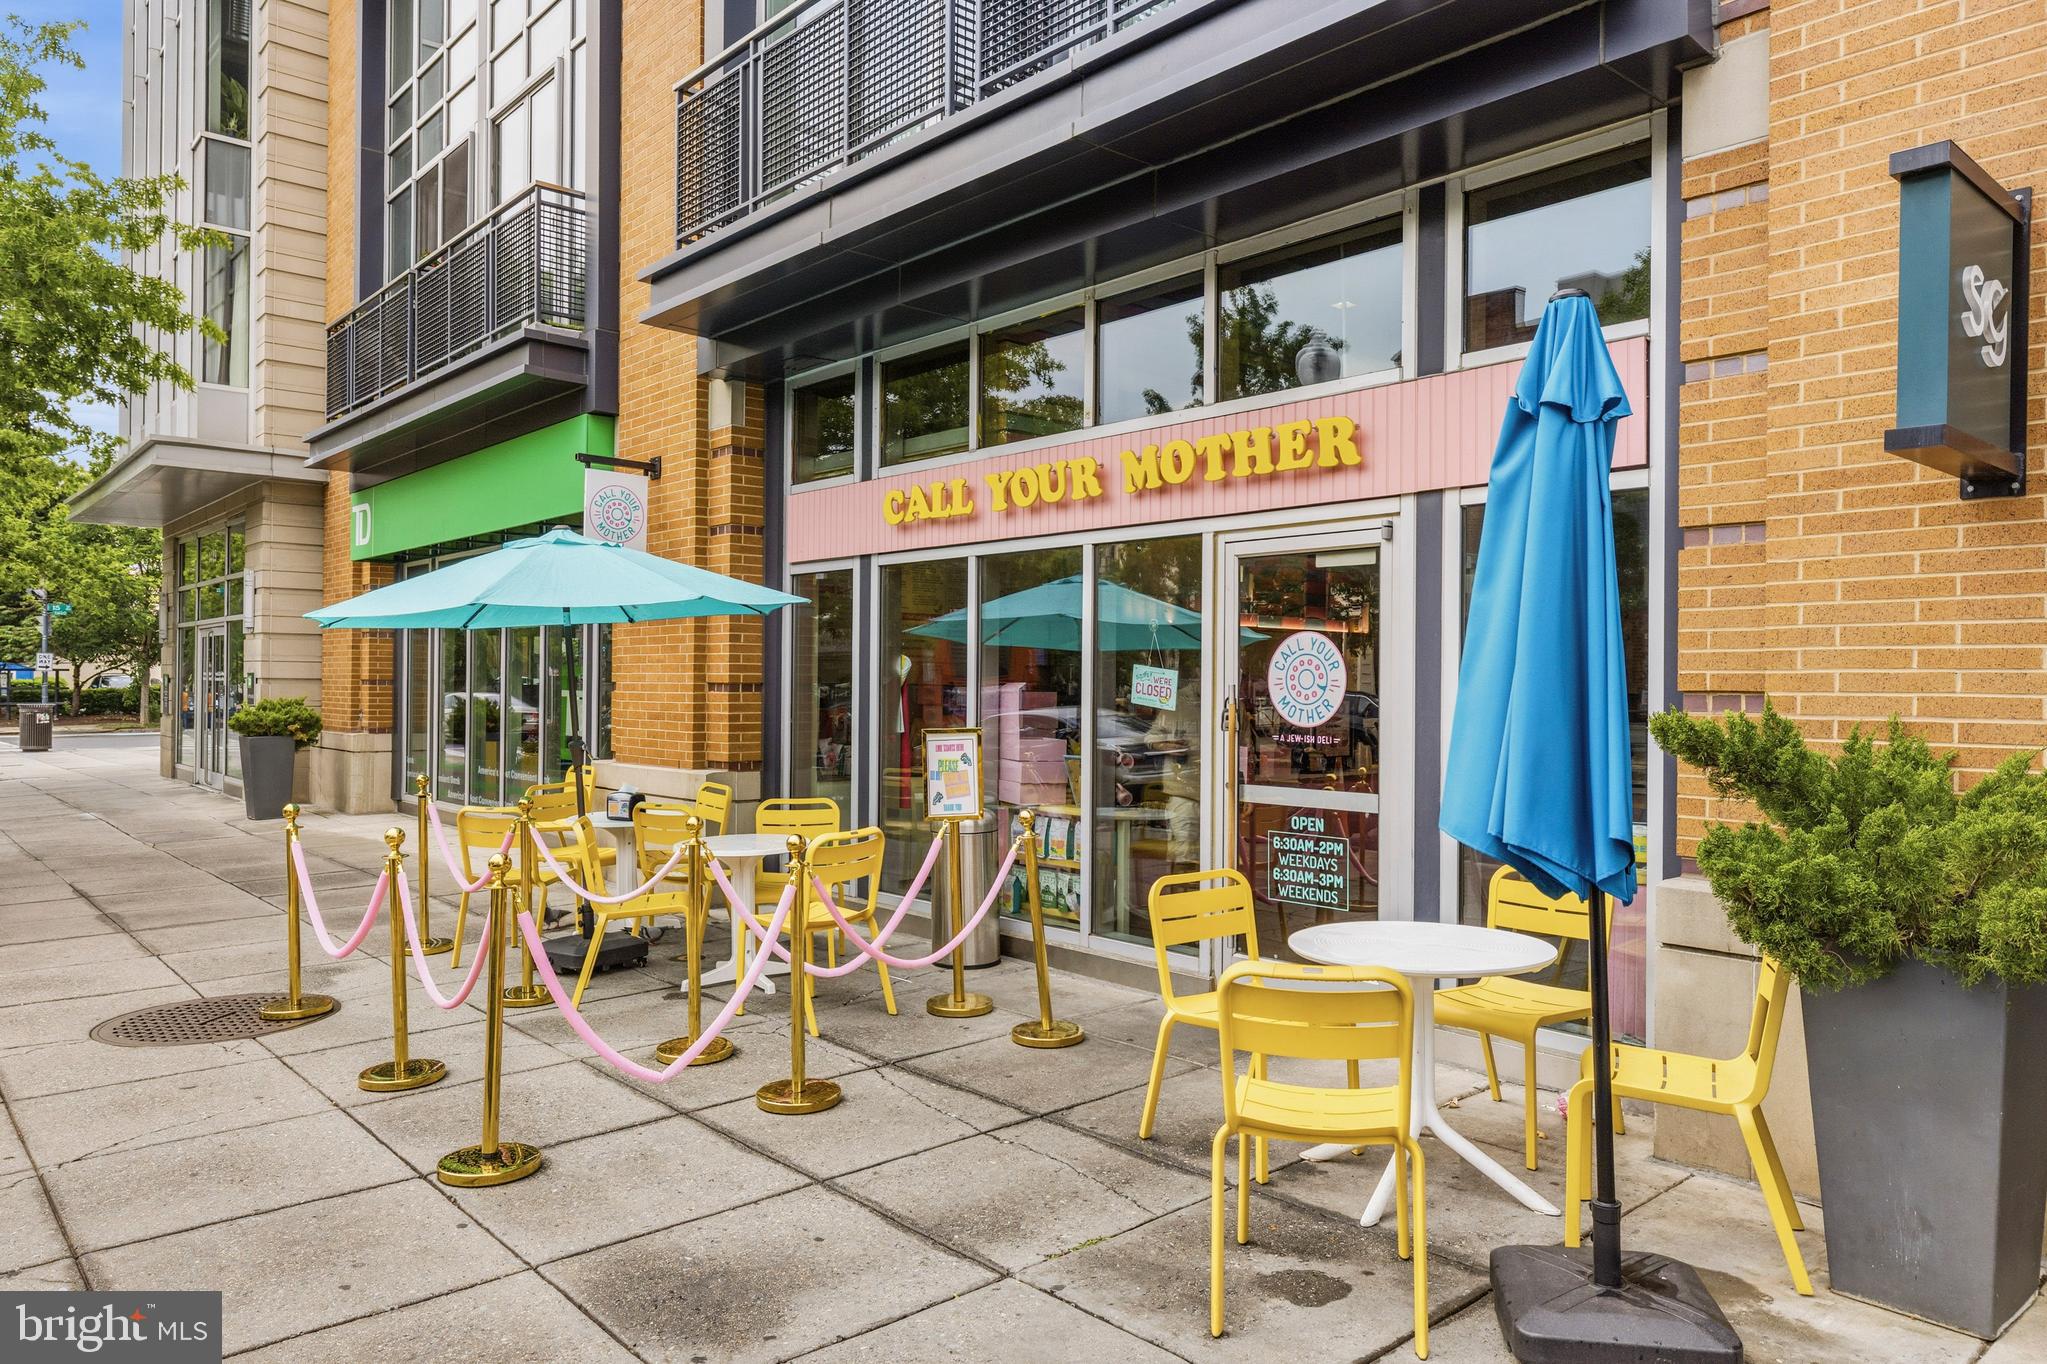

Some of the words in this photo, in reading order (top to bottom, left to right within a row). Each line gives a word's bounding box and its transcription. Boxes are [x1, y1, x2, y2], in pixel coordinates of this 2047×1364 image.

[883, 478, 973, 525] CALL
[984, 456, 1103, 512] YOUR
[1119, 415, 1362, 494] MOTHER
[594, 489, 616, 508] CALL
[620, 489, 640, 512] YOUR
[352, 503, 371, 546] TD
[596, 522, 635, 541] MOTHER
[1274, 638, 1304, 671] CALL
[1310, 637, 1340, 672] YOUR
[1135, 682, 1172, 700] CLOSED
[1278, 695, 1334, 724] MOTHER
[1280, 734, 1285, 742] A
[1286, 734, 1315, 744] JEW-ISH
[1317, 735, 1332, 745] DELI
[1291, 816, 1324, 832] OPEN
[1273, 836, 1344, 856] 6:30AM-2PM
[1278, 852, 1338, 872] WEEKDAYS
[1273, 867, 1344, 889] 6:30AM-3PM
[1277, 883, 1338, 904] WEEKENDS
